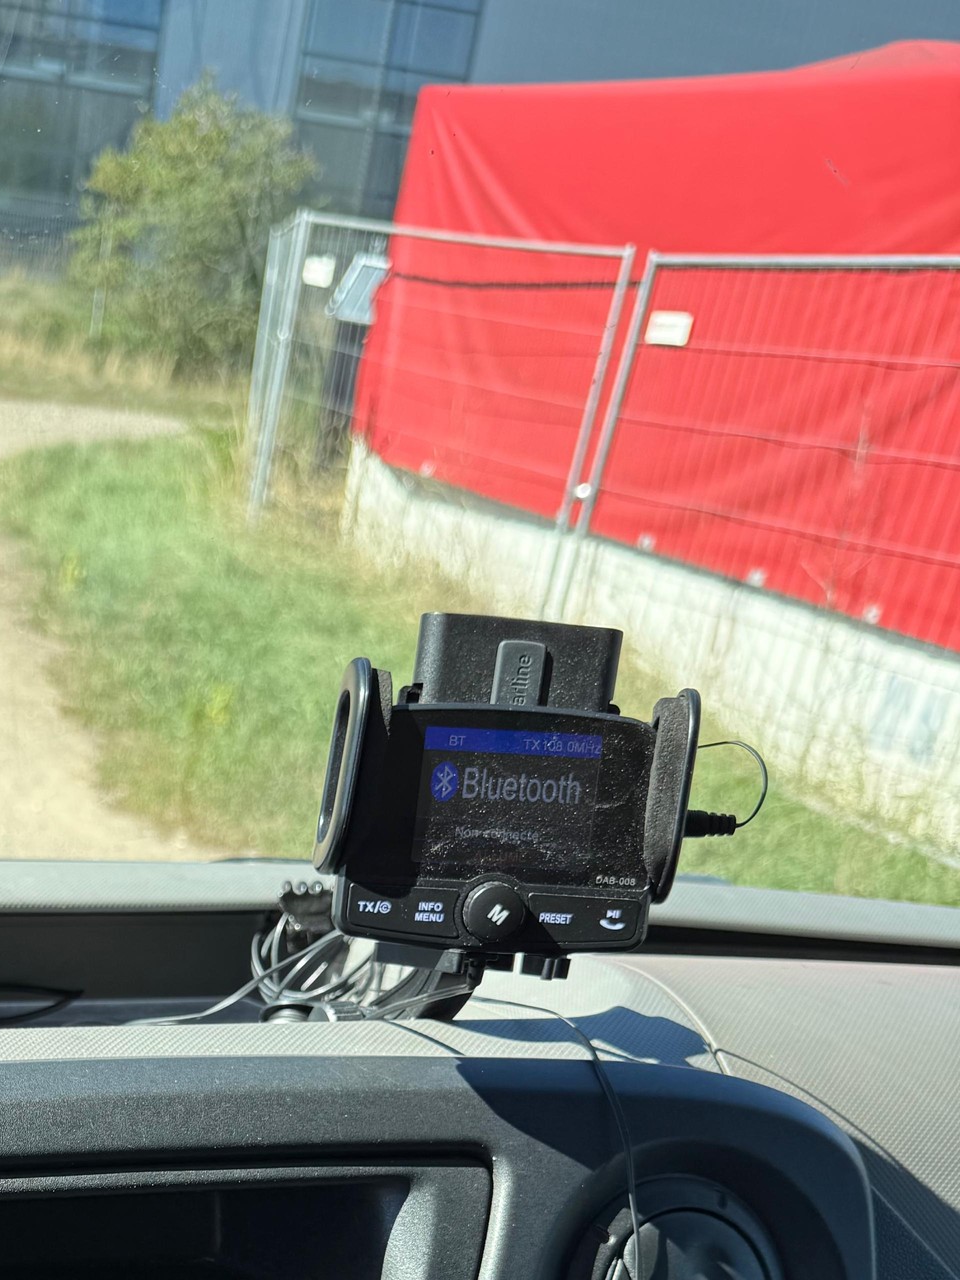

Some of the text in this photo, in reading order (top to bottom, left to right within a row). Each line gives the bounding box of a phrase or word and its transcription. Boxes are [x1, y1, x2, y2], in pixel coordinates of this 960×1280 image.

[510, 655, 533, 706] arline
[448, 735, 466, 747] BT
[461, 766, 582, 804] Bluetooth
[595, 876, 636, 887] DAB-008
[418, 902, 443, 912] INFO
[414, 912, 445, 923] MENU
[539, 912, 573, 925] PRESET
